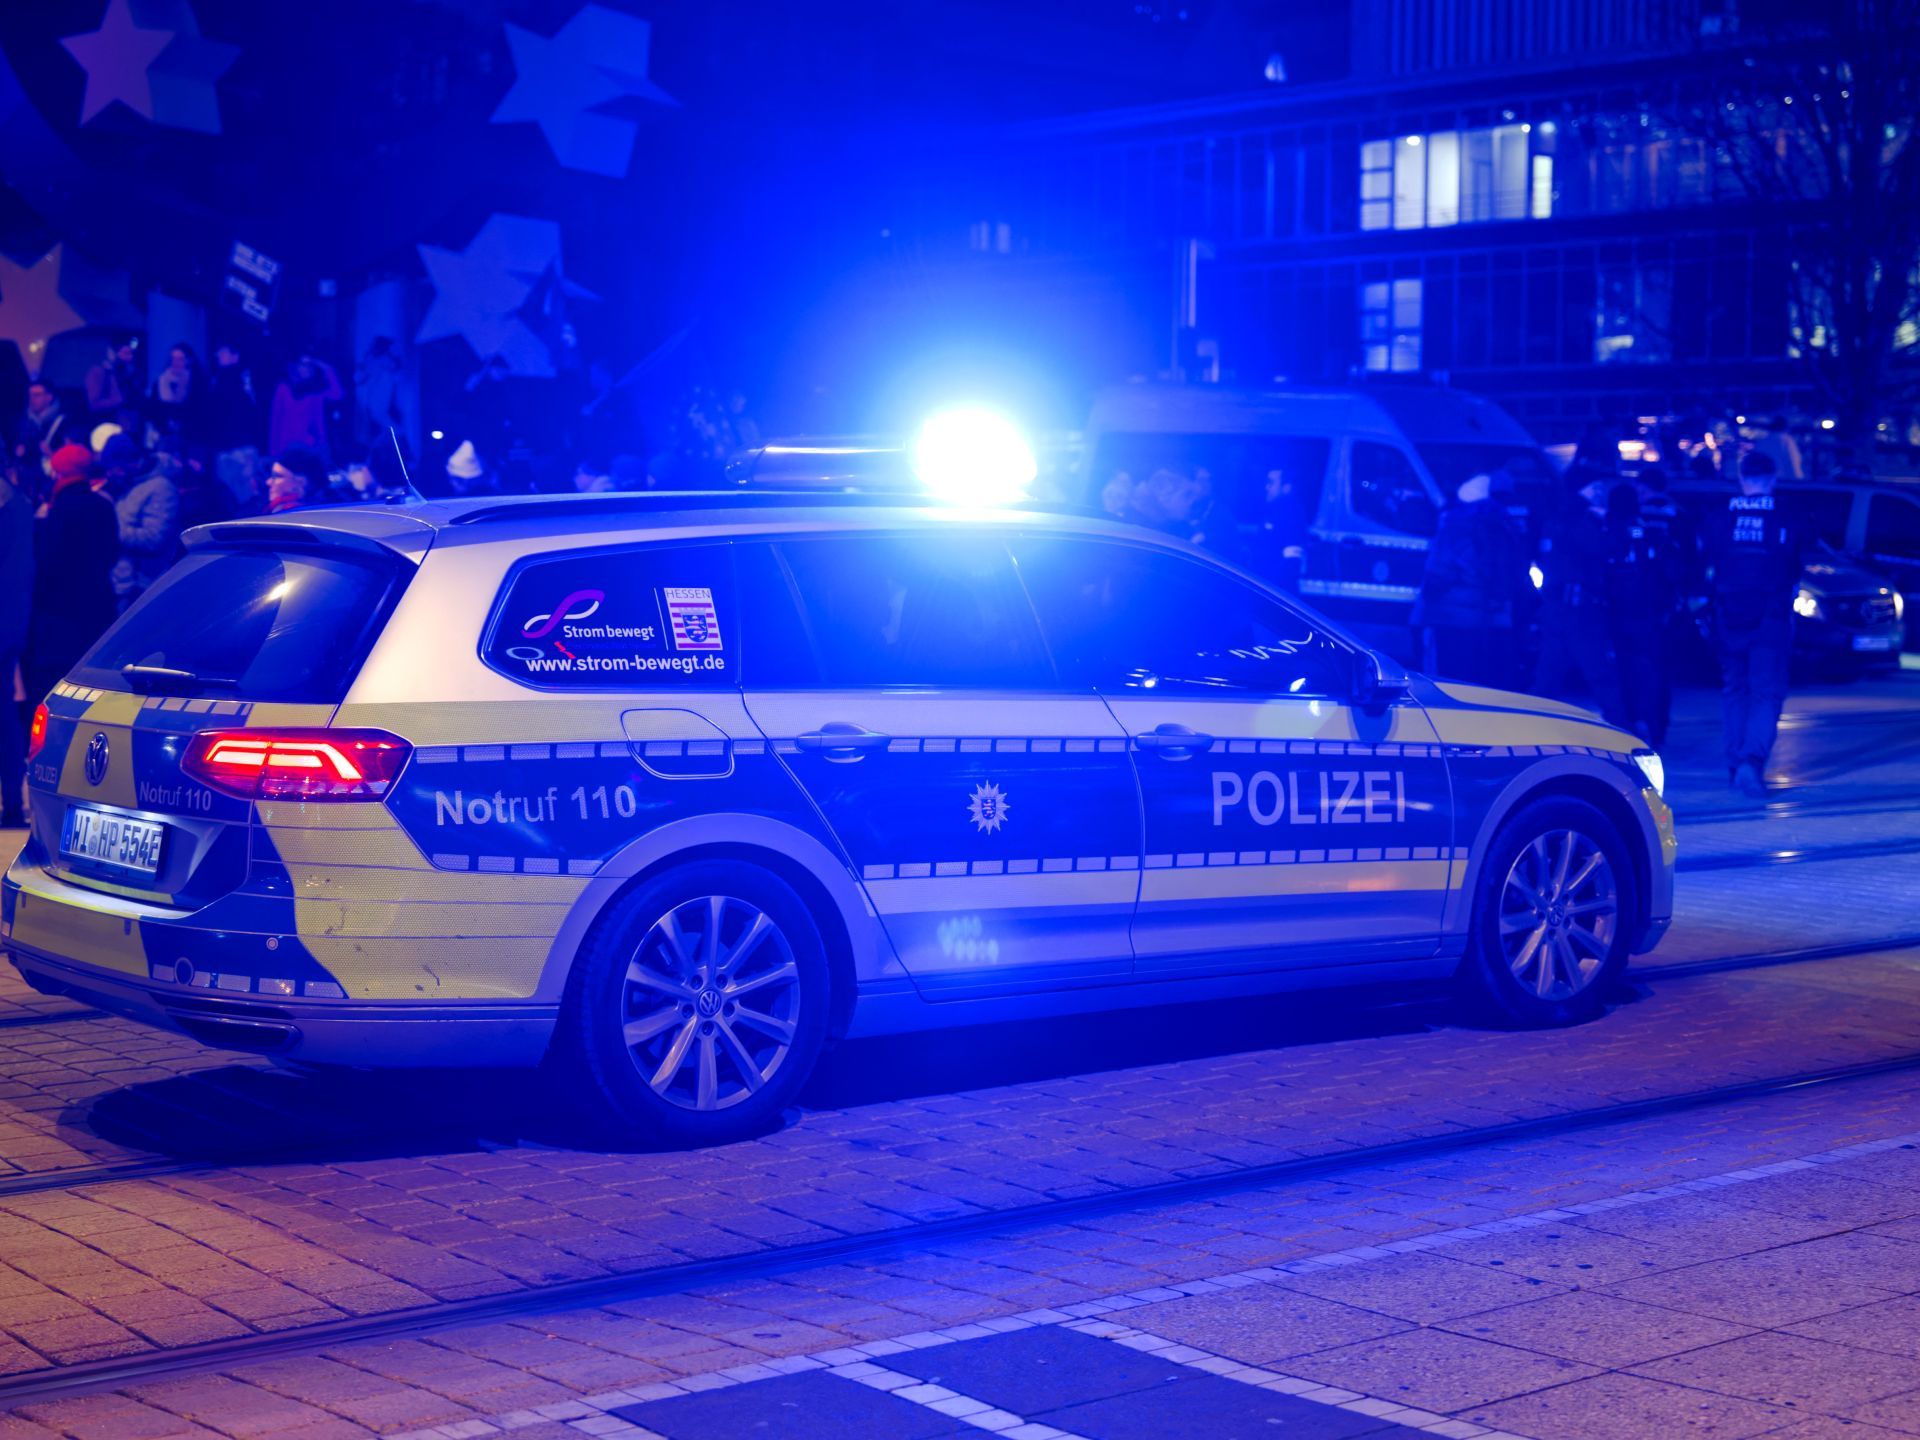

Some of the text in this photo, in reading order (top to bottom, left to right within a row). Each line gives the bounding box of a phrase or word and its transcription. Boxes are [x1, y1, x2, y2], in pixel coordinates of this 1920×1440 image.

[1729, 496, 1775, 511] POLIZEI
[665, 588, 711, 600] HESSEN
[563, 625, 655, 641] Strom bewegt
[525, 654, 725, 674] www.strom-bewegt.de
[34, 763, 58, 784] POLIZEI
[139, 781, 212, 812] Notruf 110
[435, 784, 637, 825] Notruf 110
[1212, 769, 1406, 826] POLIZEI
